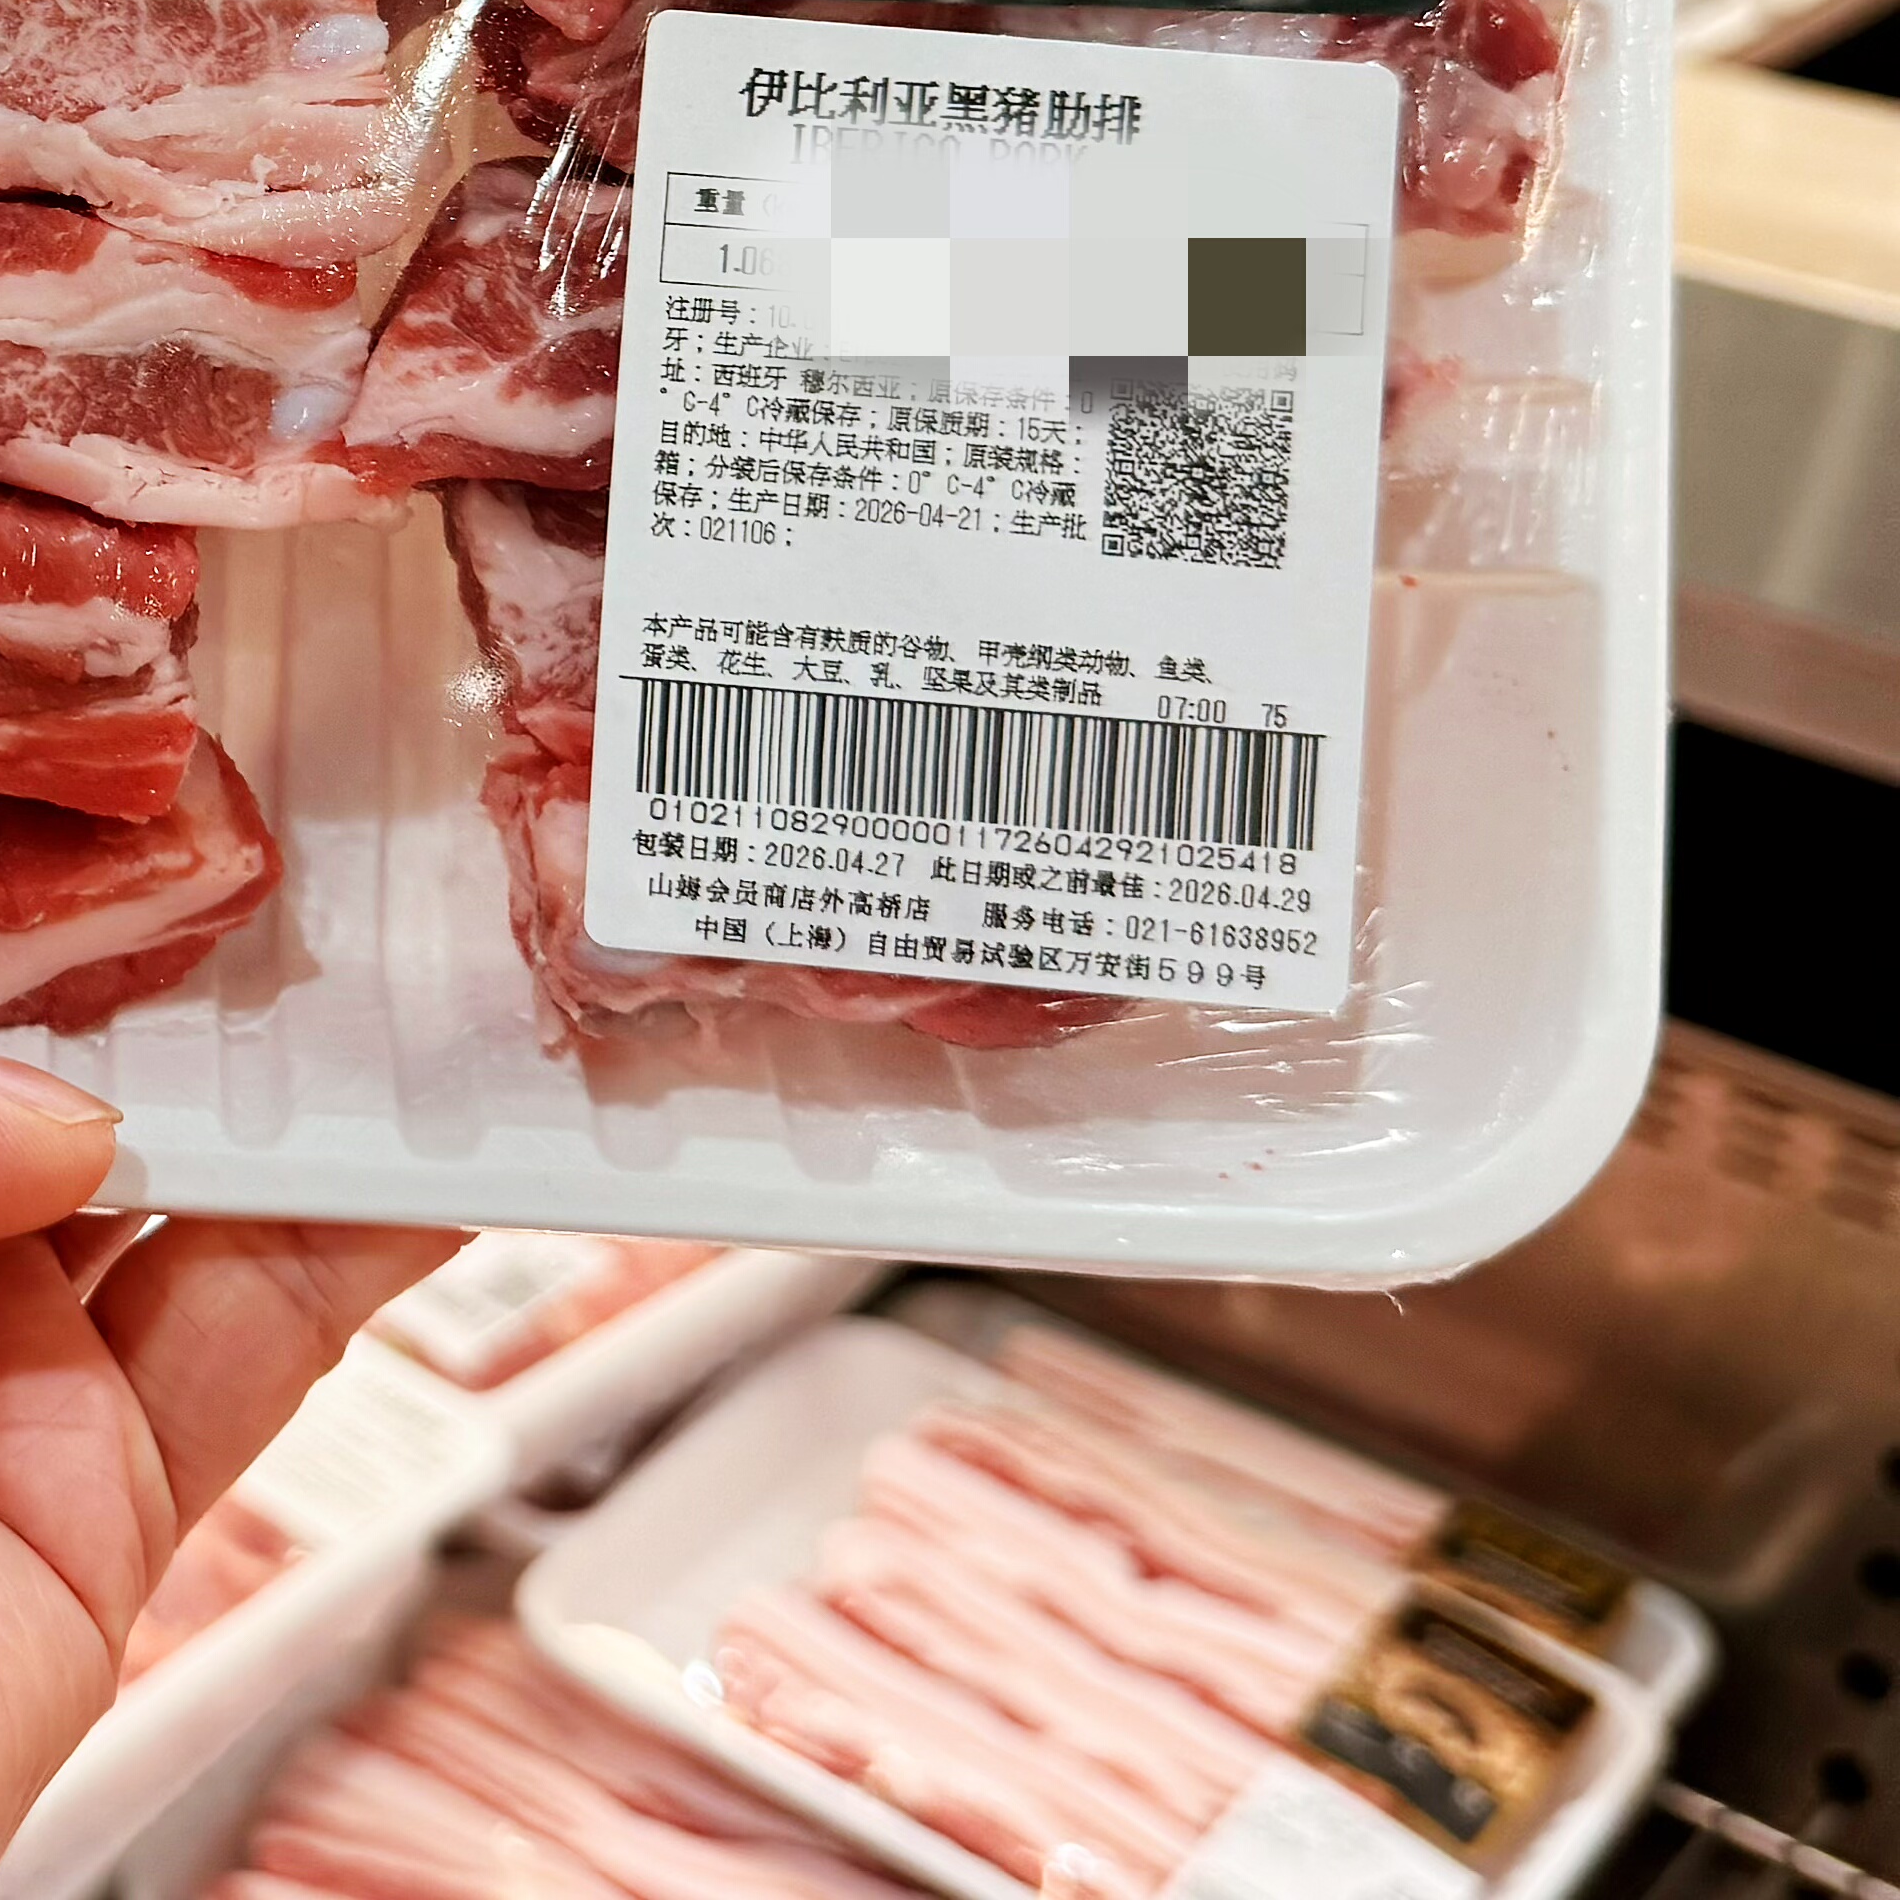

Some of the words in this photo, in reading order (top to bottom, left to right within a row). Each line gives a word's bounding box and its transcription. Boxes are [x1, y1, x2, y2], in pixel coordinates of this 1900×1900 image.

[739, 67, 1142, 145] 伊比利亚黑猪肋排
[1156, 695, 1226, 725] 07:00
[1260, 702, 1289, 729] 75
[649, 797, 1297, 875] 01021108290000011726042921025418
[649, 872, 930, 922] 山姆会员商店外高桥店
